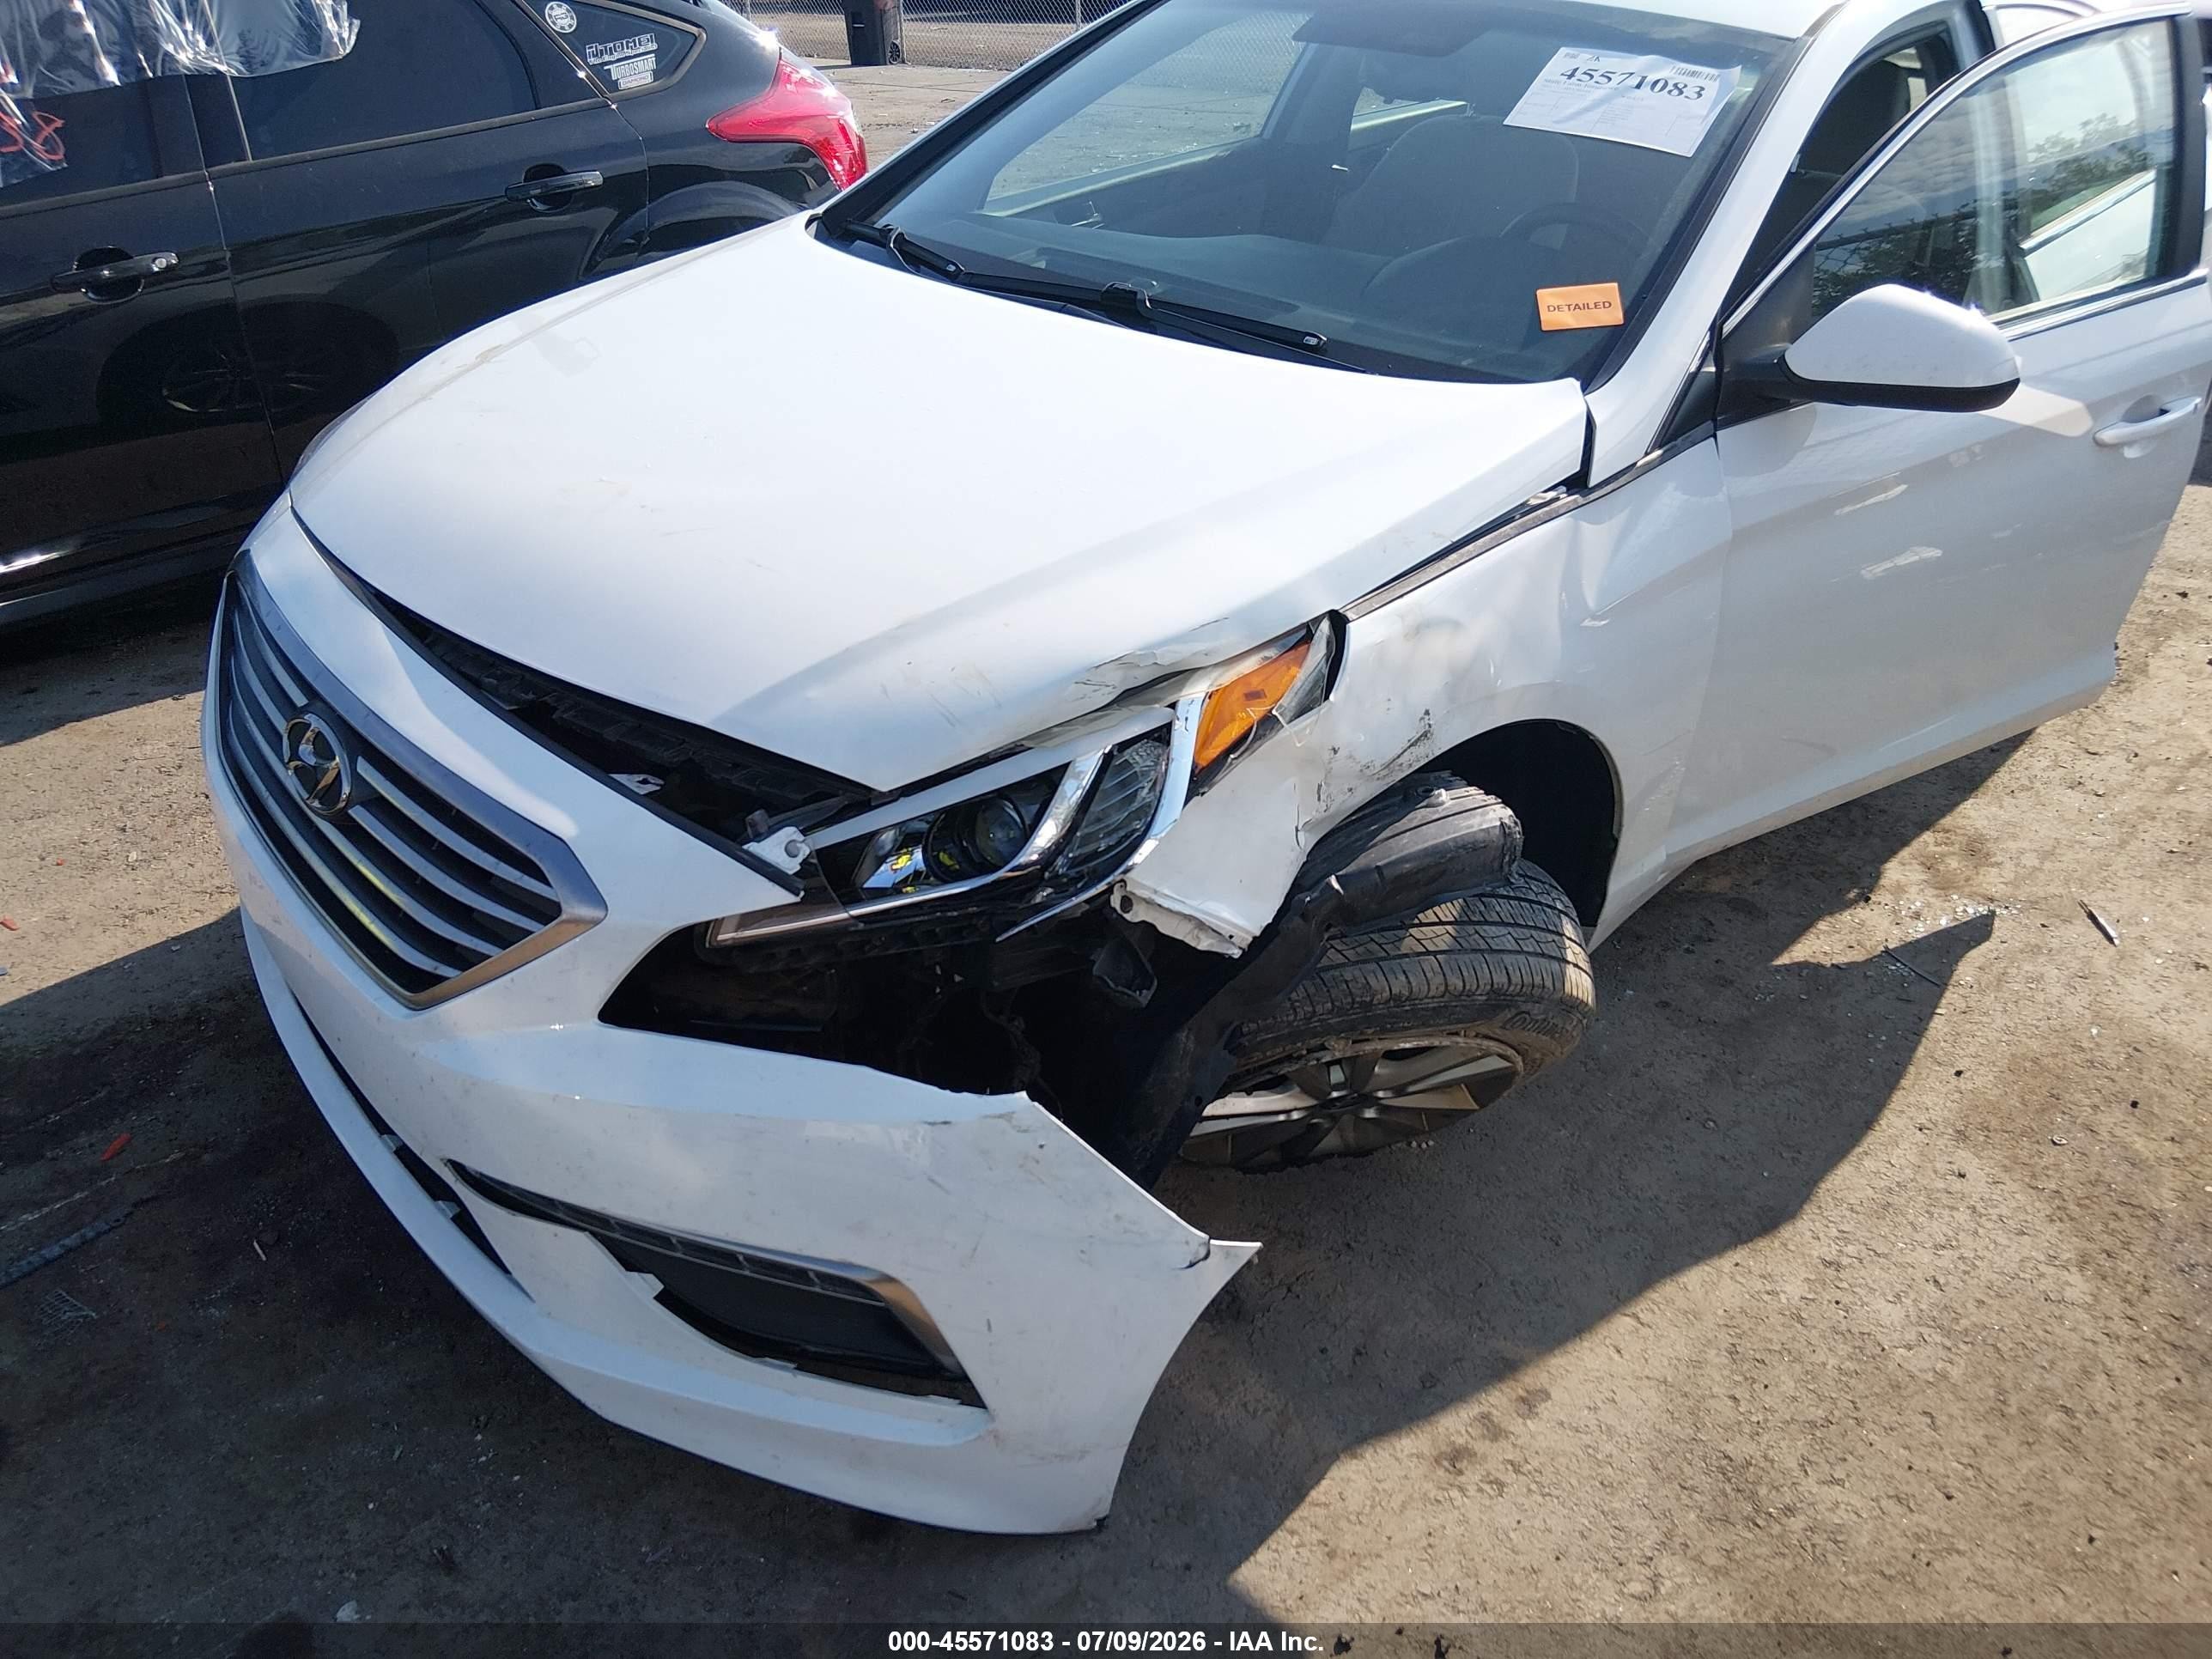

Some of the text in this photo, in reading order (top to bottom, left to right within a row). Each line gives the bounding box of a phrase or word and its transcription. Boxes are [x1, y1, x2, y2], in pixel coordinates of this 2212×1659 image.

[599, 33, 655, 57] TOMEI
[604, 54, 656, 81] TURBOSMART
[1559, 66, 1705, 100] 45571083
[1547, 301, 1612, 313] DETAILED
